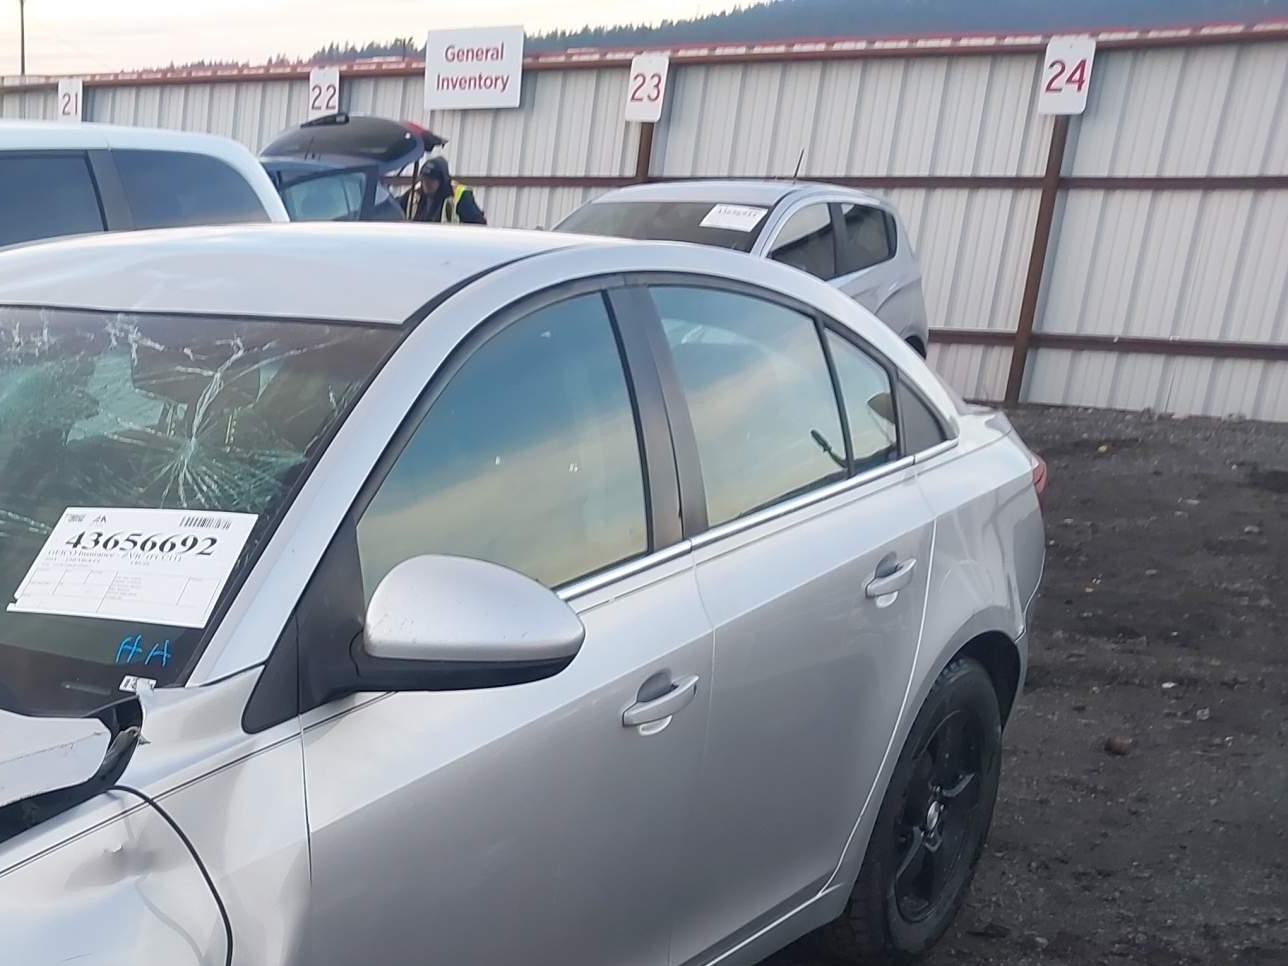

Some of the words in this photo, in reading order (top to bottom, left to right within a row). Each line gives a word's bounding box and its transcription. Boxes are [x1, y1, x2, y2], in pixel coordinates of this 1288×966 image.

[444, 42, 505, 62] General
[436, 73, 510, 92] Inventory
[630, 73, 662, 102] 23
[1045, 59, 1087, 93] 24
[62, 92, 78, 116] 21
[311, 84, 337, 110] 22
[65, 530, 218, 556] 43656692
